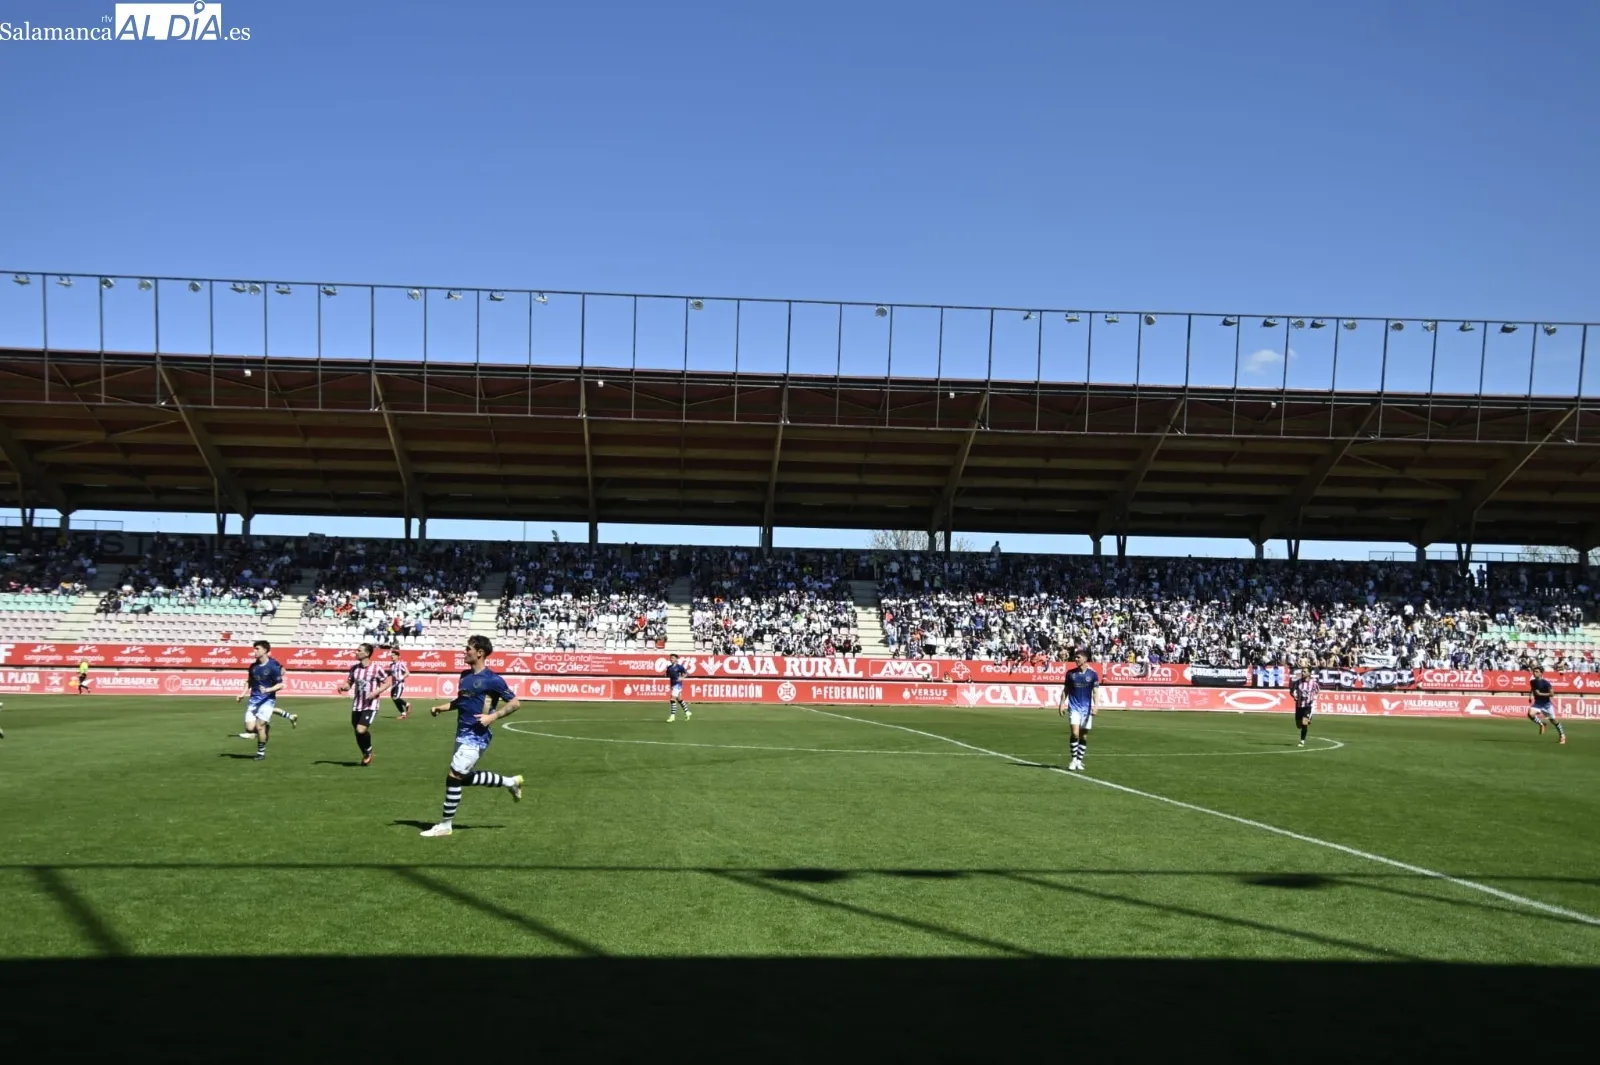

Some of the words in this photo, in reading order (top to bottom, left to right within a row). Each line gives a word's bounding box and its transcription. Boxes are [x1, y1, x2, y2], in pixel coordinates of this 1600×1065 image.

[564, 653, 591, 662] Dental
[723, 656, 779, 676] CAJA
[783, 657, 864, 678] RURAL
[7, 672, 40, 684] PLATA
[181, 677, 208, 687] ELOY
[209, 674, 247, 688] ÁLVARE
[543, 684, 579, 693] INNOVA
[581, 684, 606, 696] Chef
[632, 684, 671, 693] VERSUS
[702, 682, 763, 698] FEDERACIÓN
[823, 684, 883, 700] FEDERACIÓN
[911, 688, 948, 697] VERSUS
[984, 685, 1041, 706] CAJA
[1334, 694, 1366, 702] DENTAL
[1320, 702, 1334, 713] DE
[1336, 703, 1368, 714] PAULA
[1557, 698, 1572, 714] La
